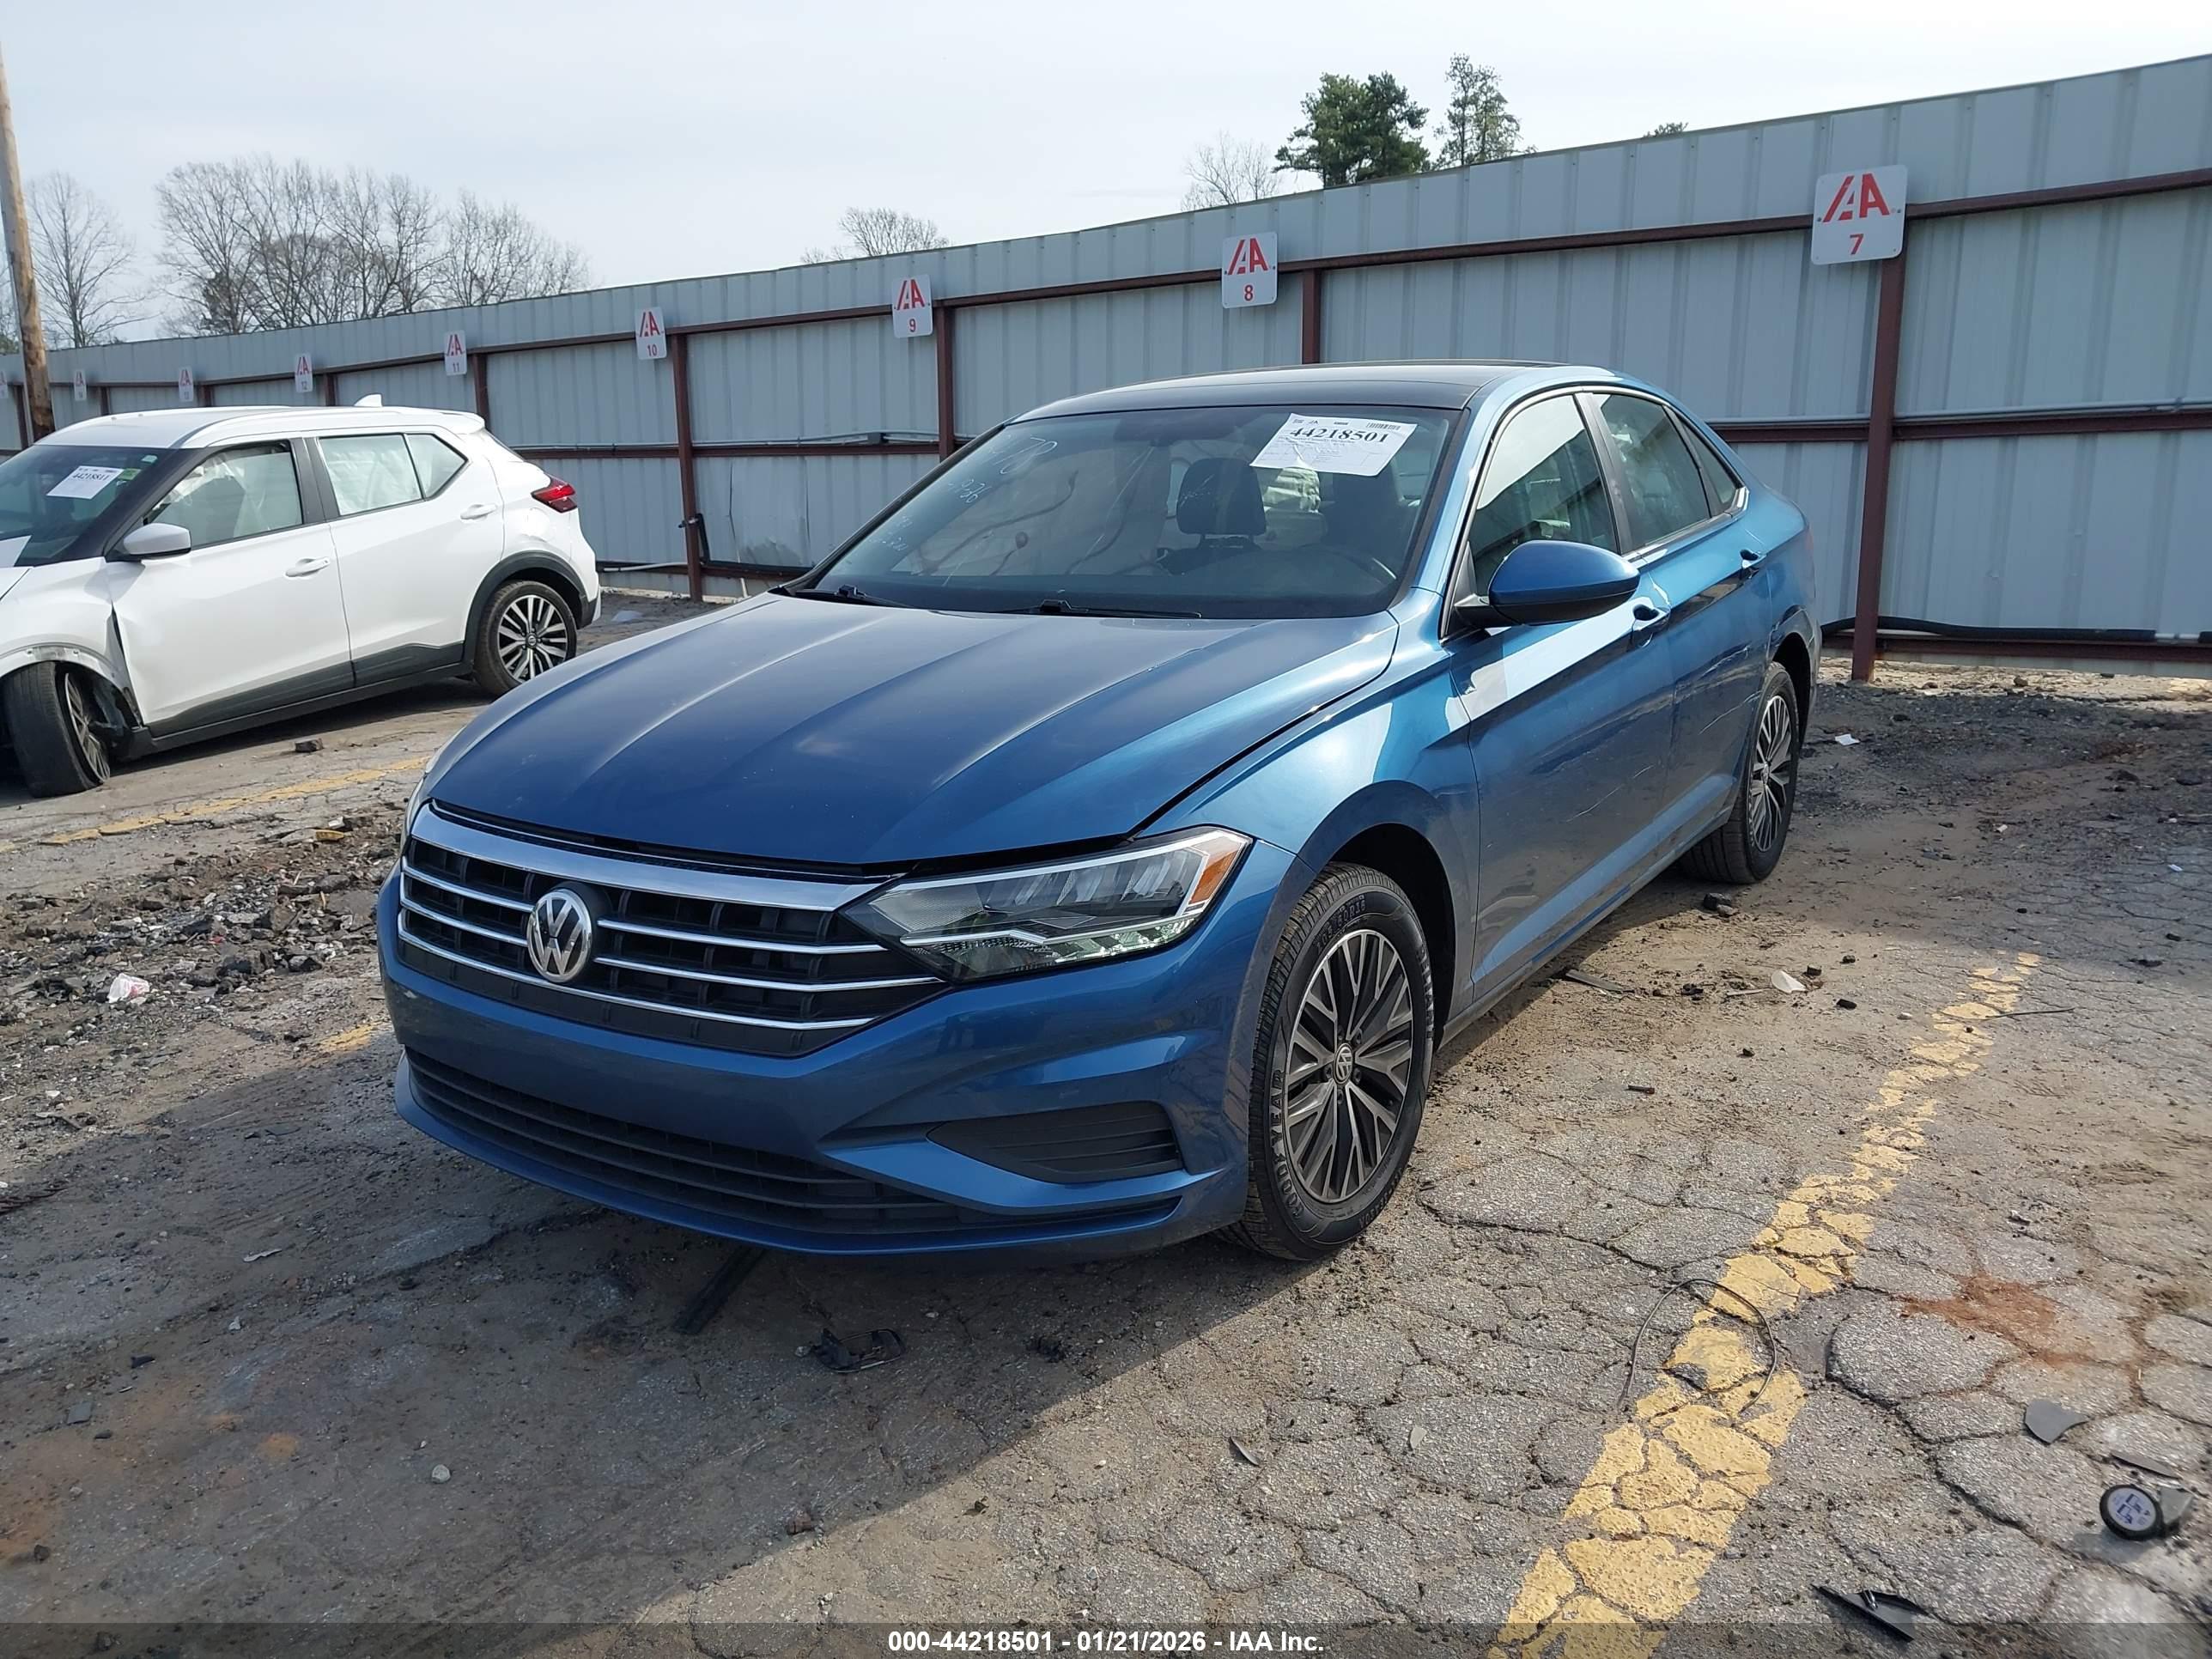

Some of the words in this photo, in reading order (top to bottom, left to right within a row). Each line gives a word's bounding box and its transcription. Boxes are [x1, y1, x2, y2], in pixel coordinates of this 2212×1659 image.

[1850, 234, 1864, 255] 7
[1244, 284, 1254, 301] 8
[909, 319, 916, 332] 9
[647, 344, 658, 356] 10
[453, 362, 459, 373] 11
[1290, 428, 1389, 443] 44218501
